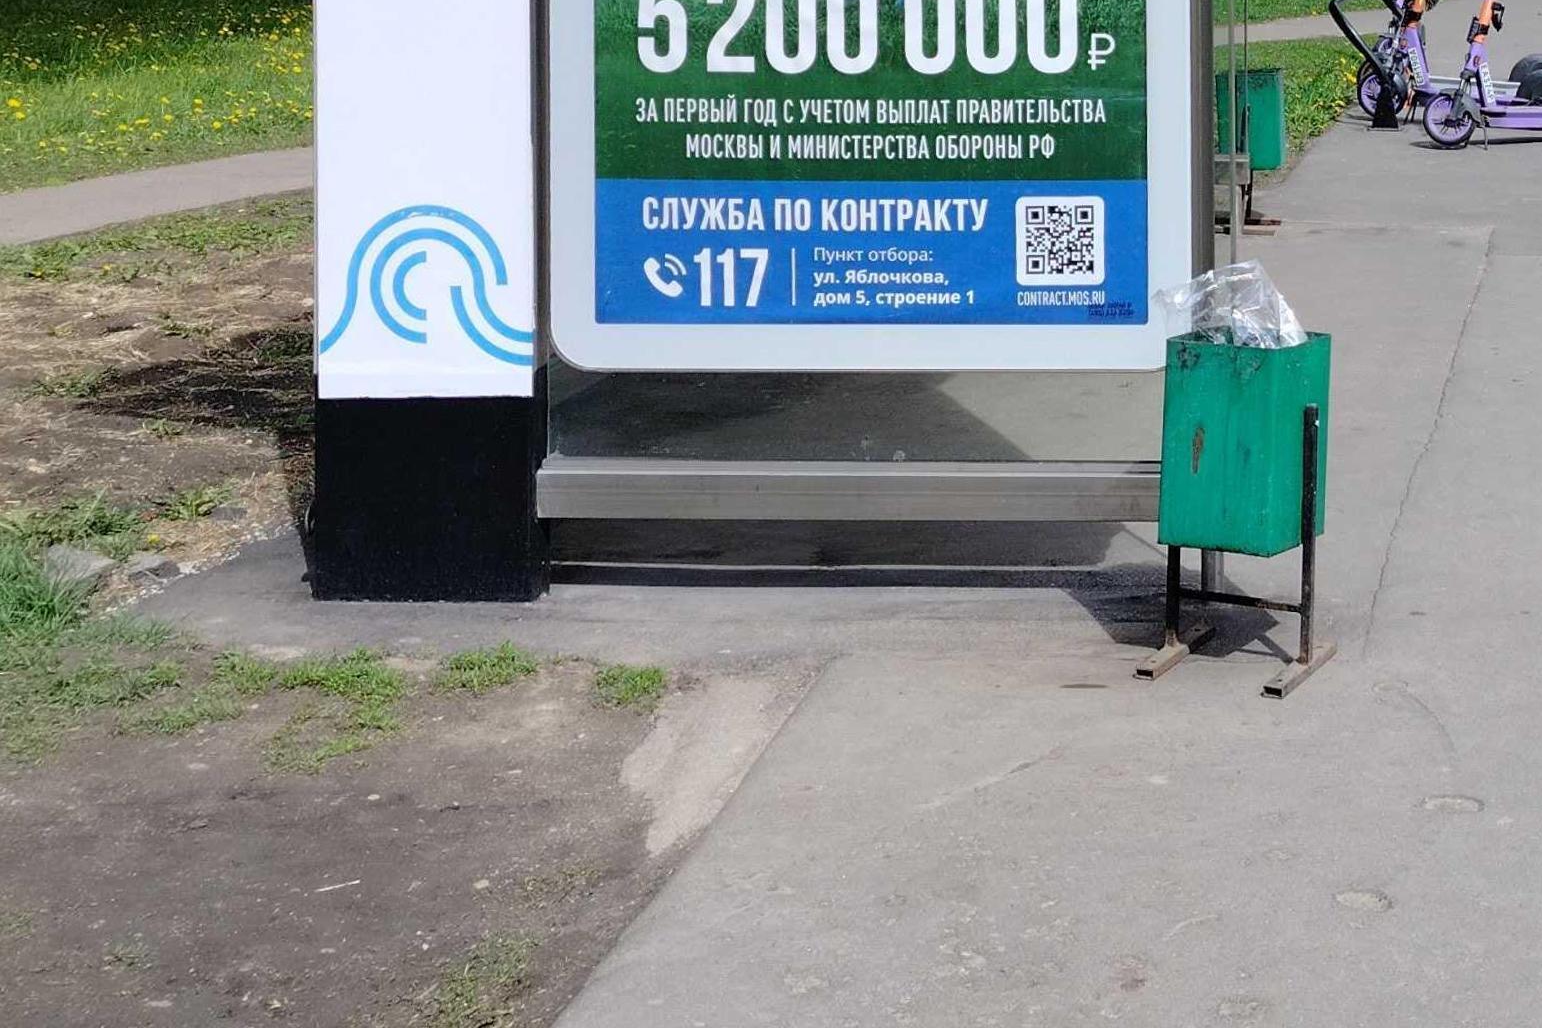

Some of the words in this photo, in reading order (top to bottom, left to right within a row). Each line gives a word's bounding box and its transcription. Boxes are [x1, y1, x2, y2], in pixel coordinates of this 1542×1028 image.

[635, 97, 659, 123] ЗА
[663, 94, 738, 123] ПЕРВЫЙ
[743, 98, 778, 126] ГОД
[783, 98, 794, 123] С
[799, 98, 870, 123] УЧЕТОМ
[876, 99, 951, 123] ВЫПЛАТ
[956, 98, 1107, 123] ПРАВИТЕЛЬСТВА
[685, 133, 763, 159] МОСКВЫ
[769, 134, 781, 159] И
[787, 134, 930, 159] МИНИСТЕРСТВА
[935, 134, 1023, 159] ОБОРОНЫ
[1028, 133, 1056, 160] РФ
[641, 196, 766, 231] СЛУЖБА
[773, 198, 812, 232] ПО
[820, 198, 989, 232] КОНТРАКТУ
[813, 247, 864, 265] Пункт
[867, 246, 934, 265] отбора:
[692, 247, 770, 308] 117
[813, 271, 841, 287] ул.
[844, 269, 950, 286] Яблочкова,
[813, 292, 851, 307] дом
[855, 290, 871, 306] 5,
[875, 291, 962, 308] строение
[966, 290, 975, 304] 1
[1016, 290, 1106, 306] CONTRACT.MOS.RU
